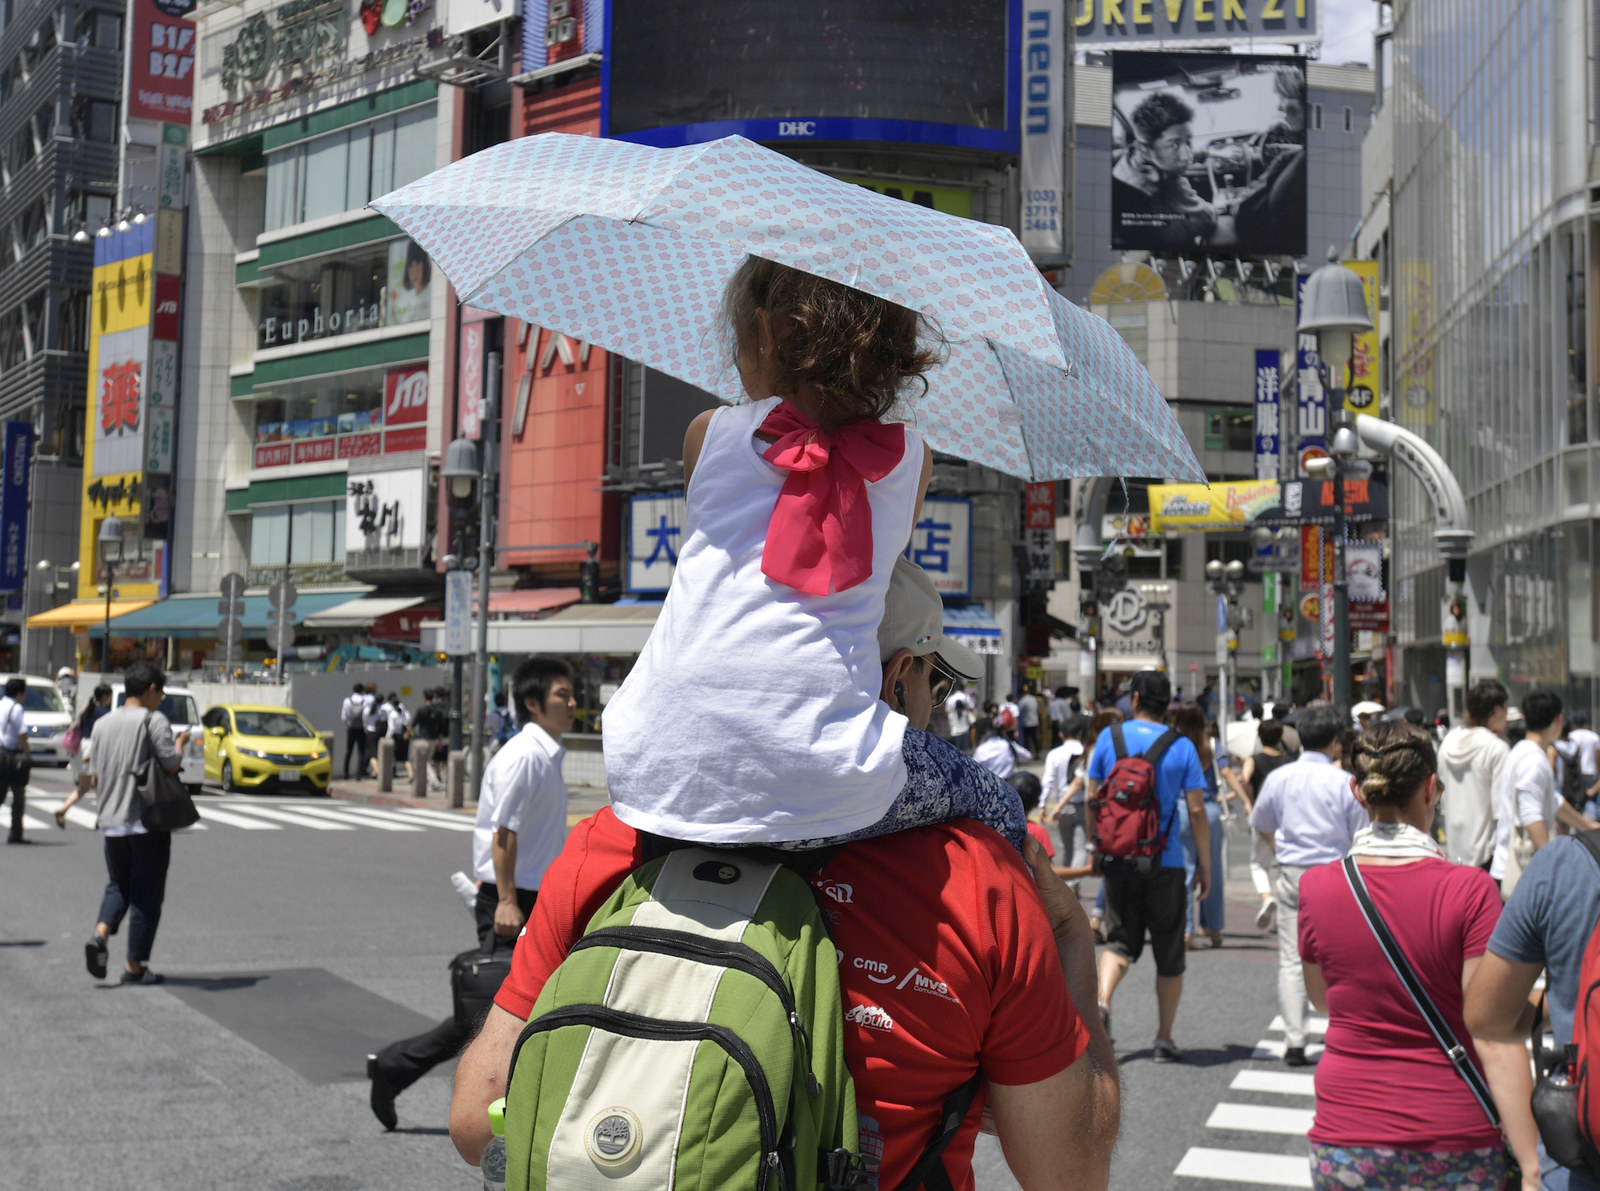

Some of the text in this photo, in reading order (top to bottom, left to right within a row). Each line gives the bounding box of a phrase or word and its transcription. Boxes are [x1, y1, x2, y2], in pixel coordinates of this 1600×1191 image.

[149, 50, 194, 79] B2F
[1027, 9, 1050, 135] neon
[778, 121, 816, 136] DHC
[1027, 189, 1056, 203] (03)
[1025, 205, 1058, 217] 3719
[156, 301, 178, 314] JTB
[264, 298, 380, 344] Euphoria
[101, 359, 142, 438] 薬
[388, 370, 428, 416] JTB
[1350, 389, 1372, 407] 4F
[904, 518, 952, 574] 店
[915, 974, 948, 994] MVS
